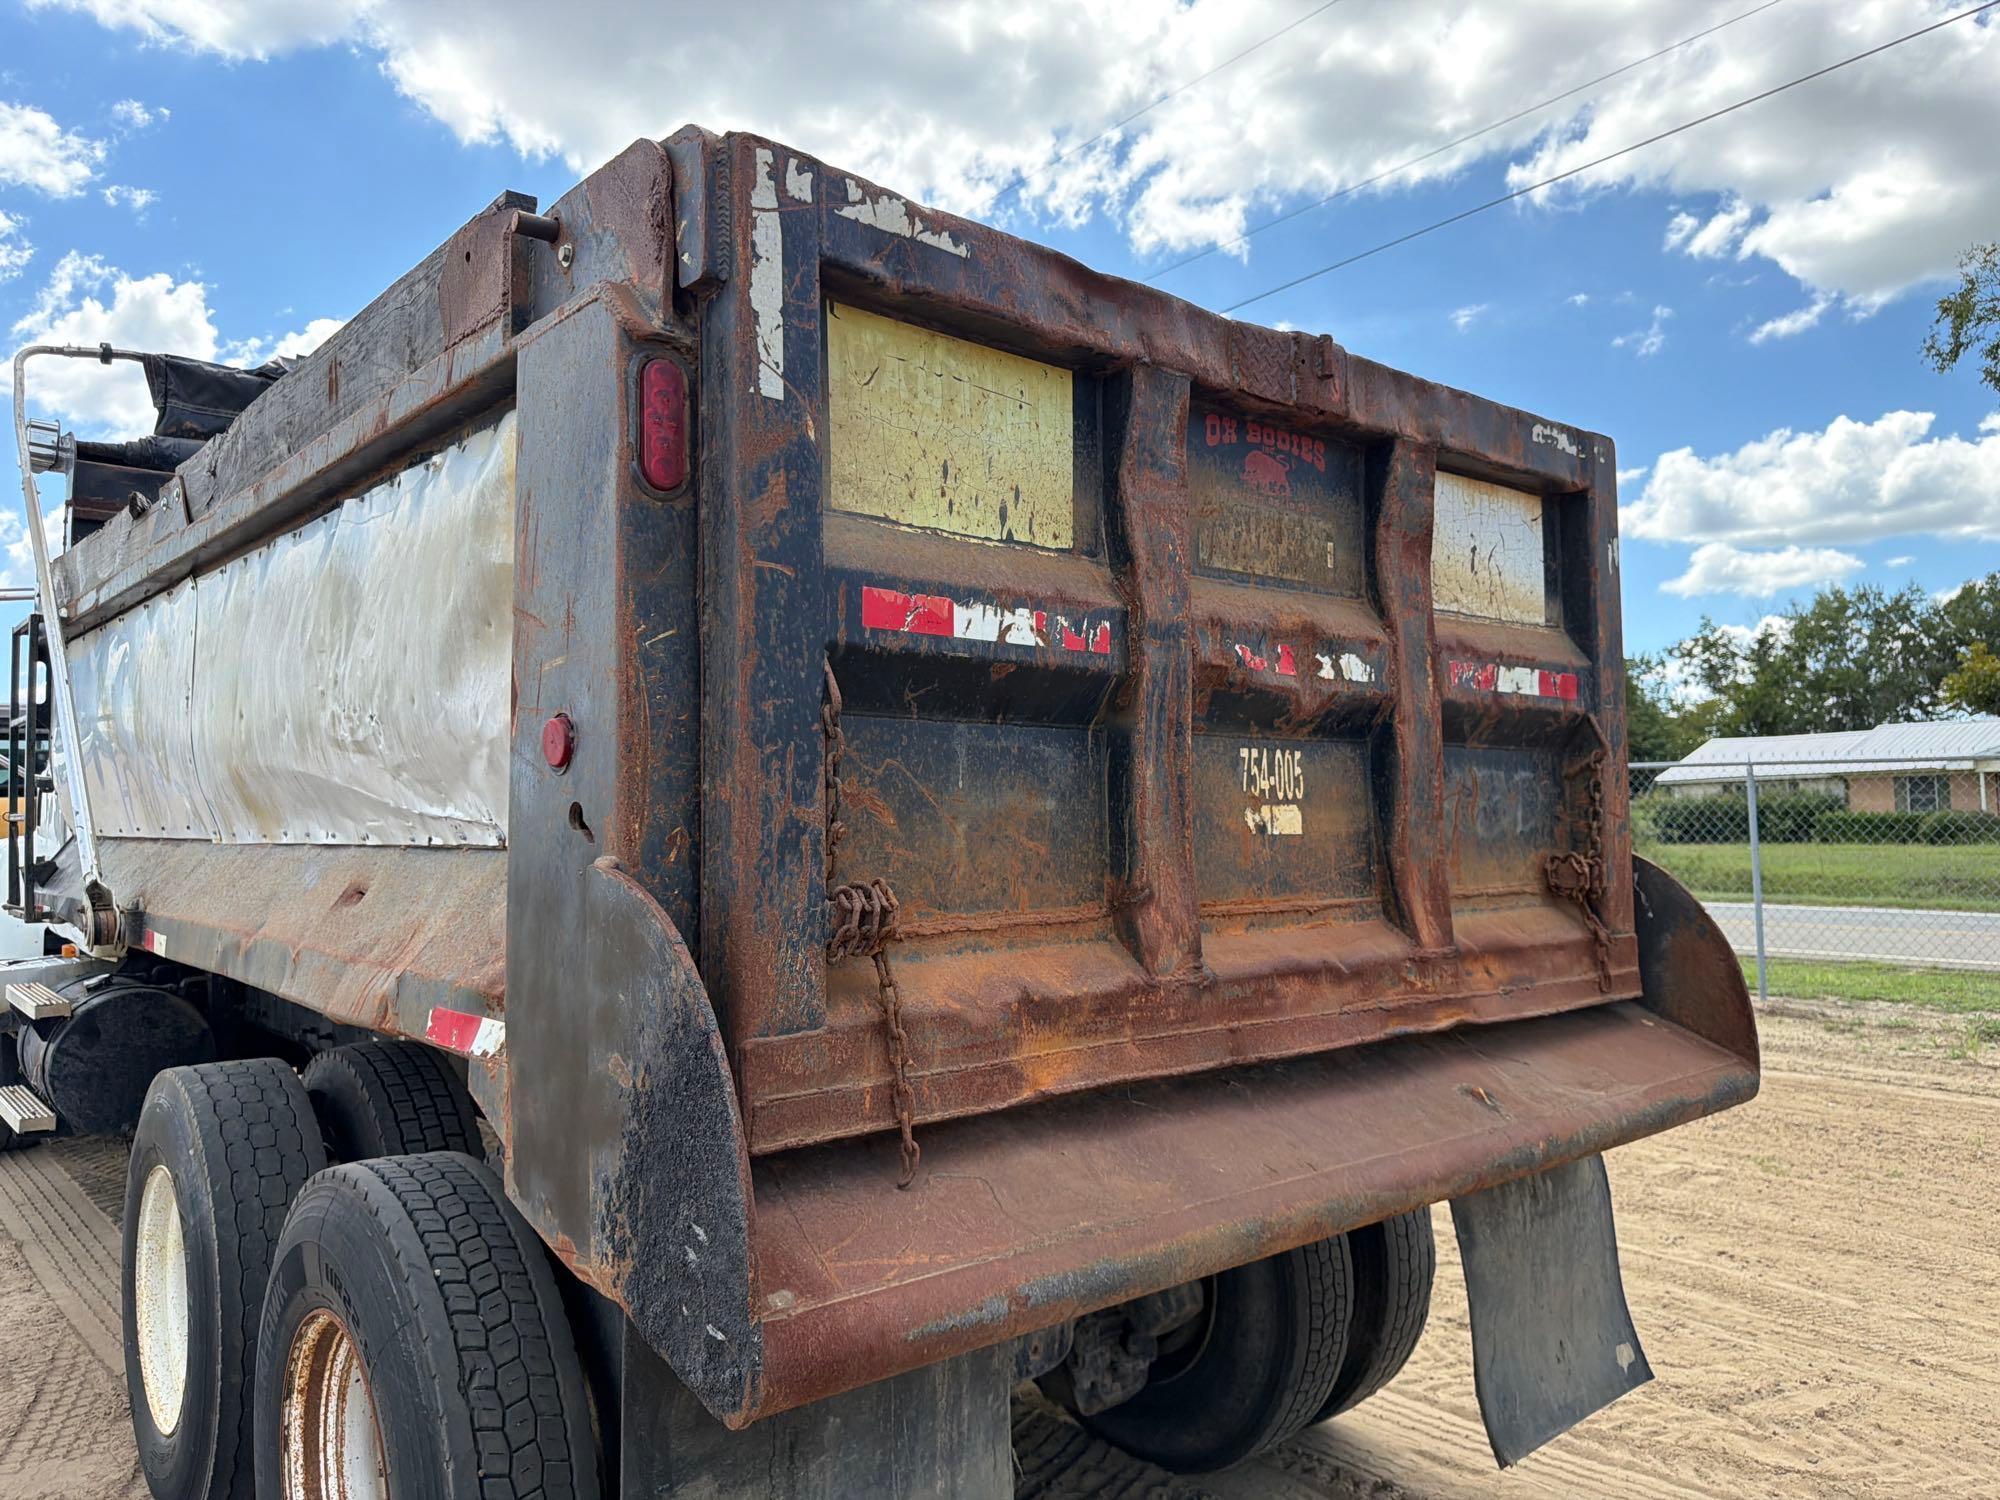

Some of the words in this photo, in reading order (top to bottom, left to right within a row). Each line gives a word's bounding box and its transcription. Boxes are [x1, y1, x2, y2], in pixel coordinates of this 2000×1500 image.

[1206, 414, 1237, 447] OX
[1246, 422, 1326, 473] BODIES
[1240, 748, 1303, 800] 754-005
